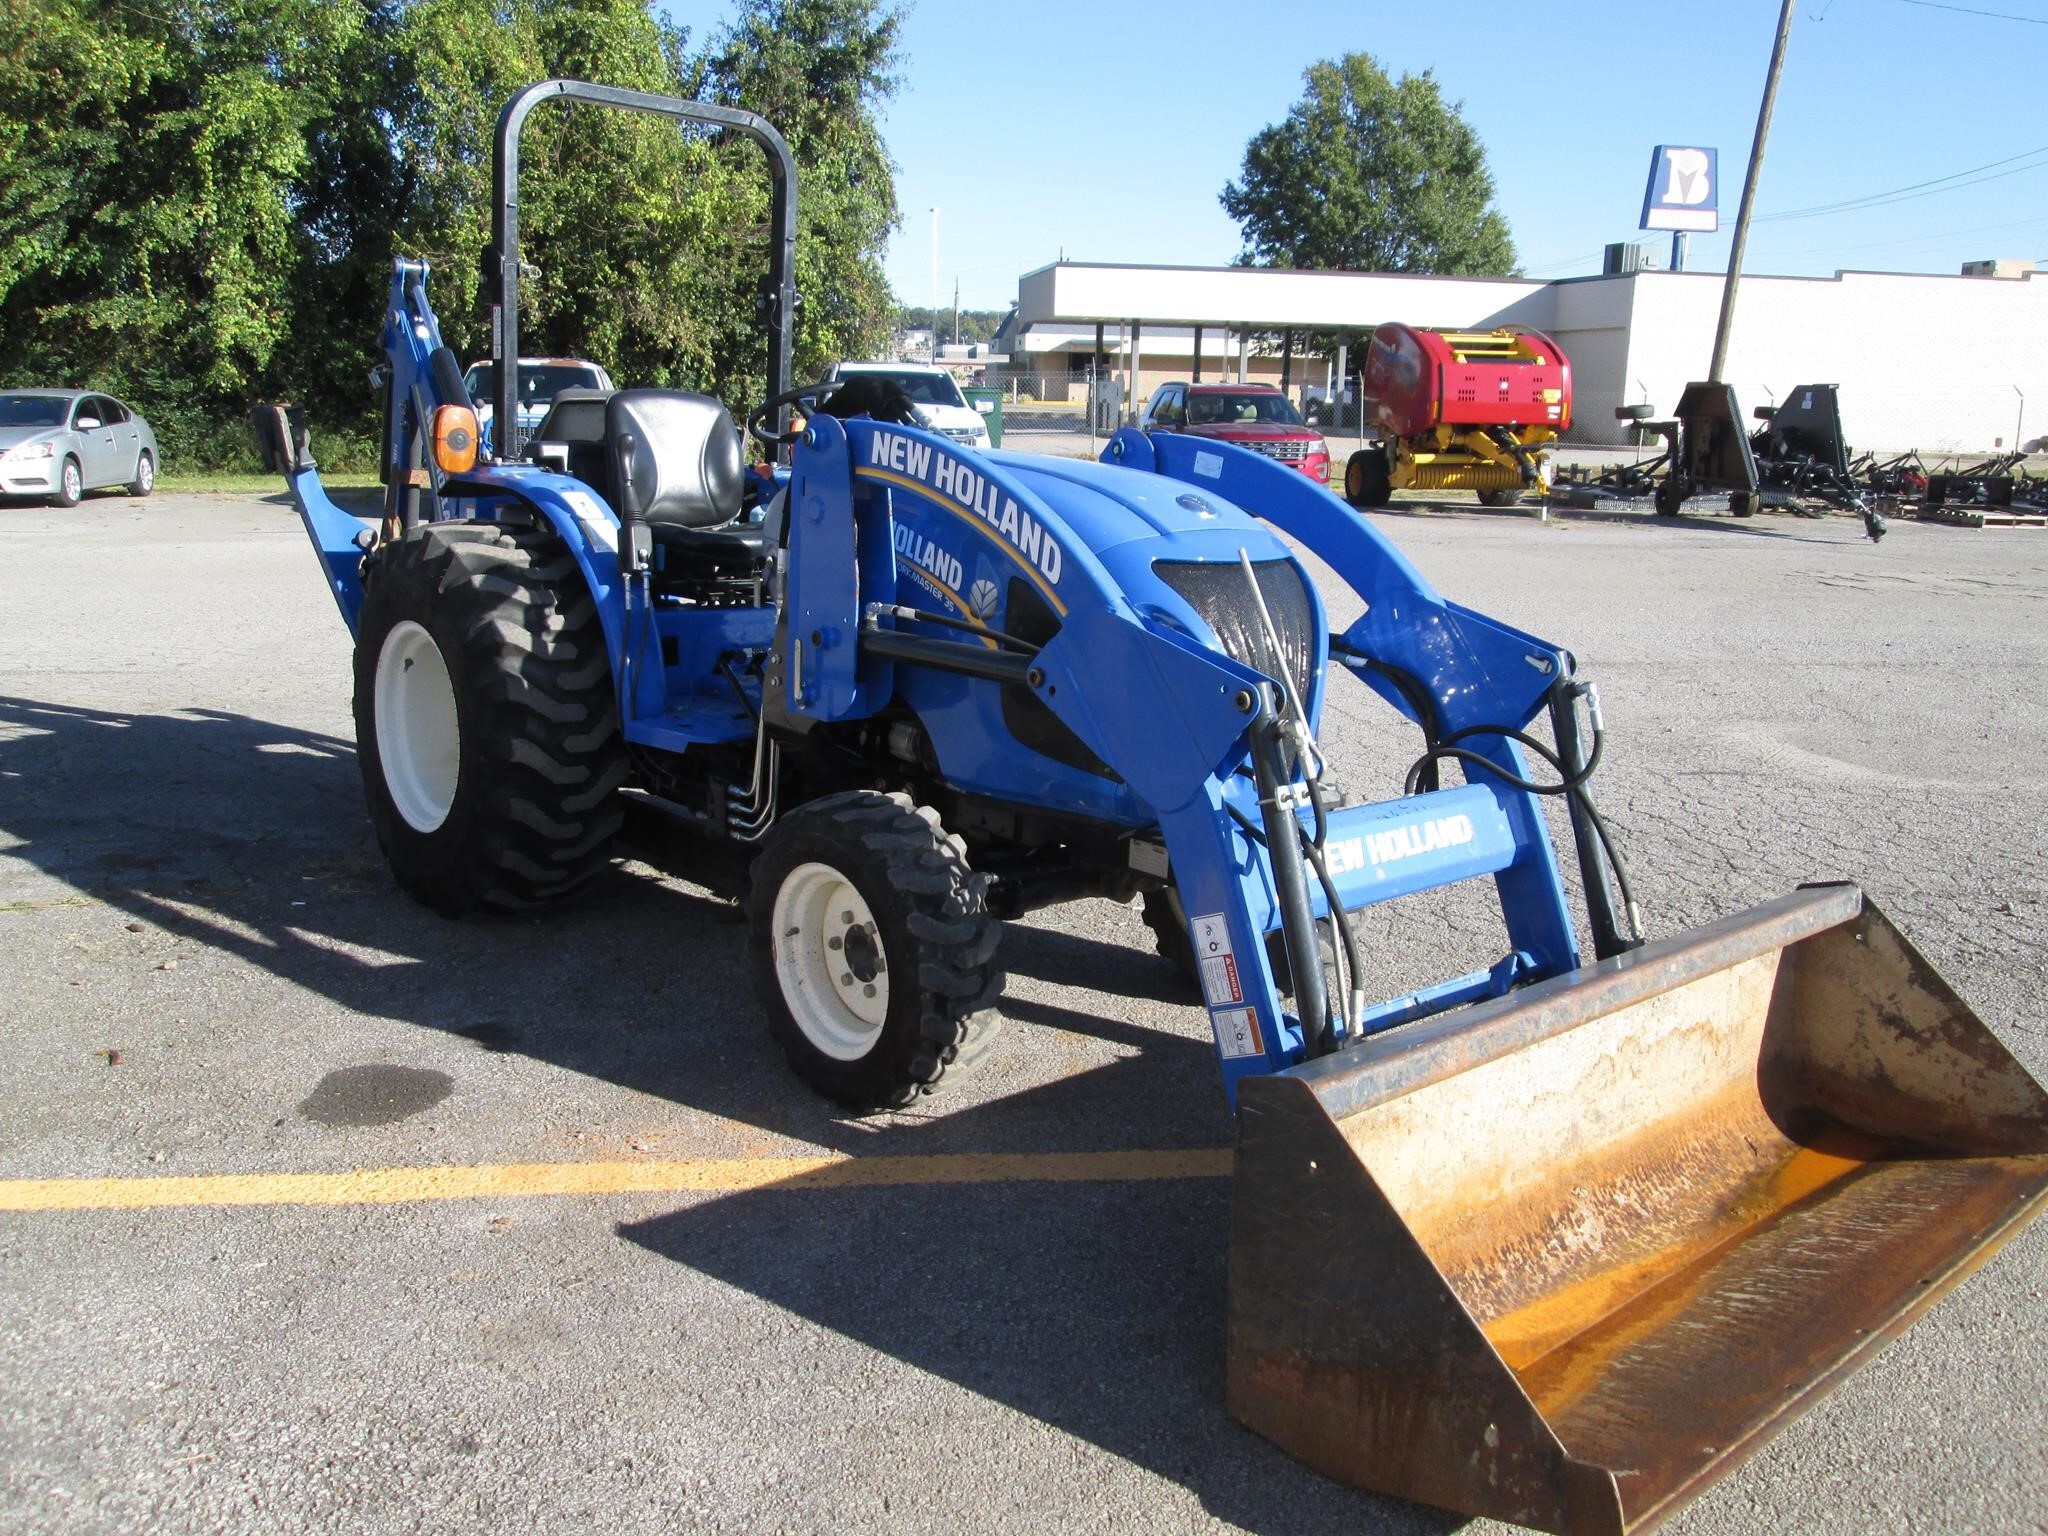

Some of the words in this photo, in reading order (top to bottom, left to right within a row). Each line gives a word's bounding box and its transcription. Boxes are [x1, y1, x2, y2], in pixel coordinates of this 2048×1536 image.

[871, 431, 932, 481] NEW
[935, 452, 1062, 585] HOLLAND
[894, 521, 962, 592] OLLAND
[1365, 814, 1473, 865] HOLLAND
[1228, 966, 1240, 998] DANGER
